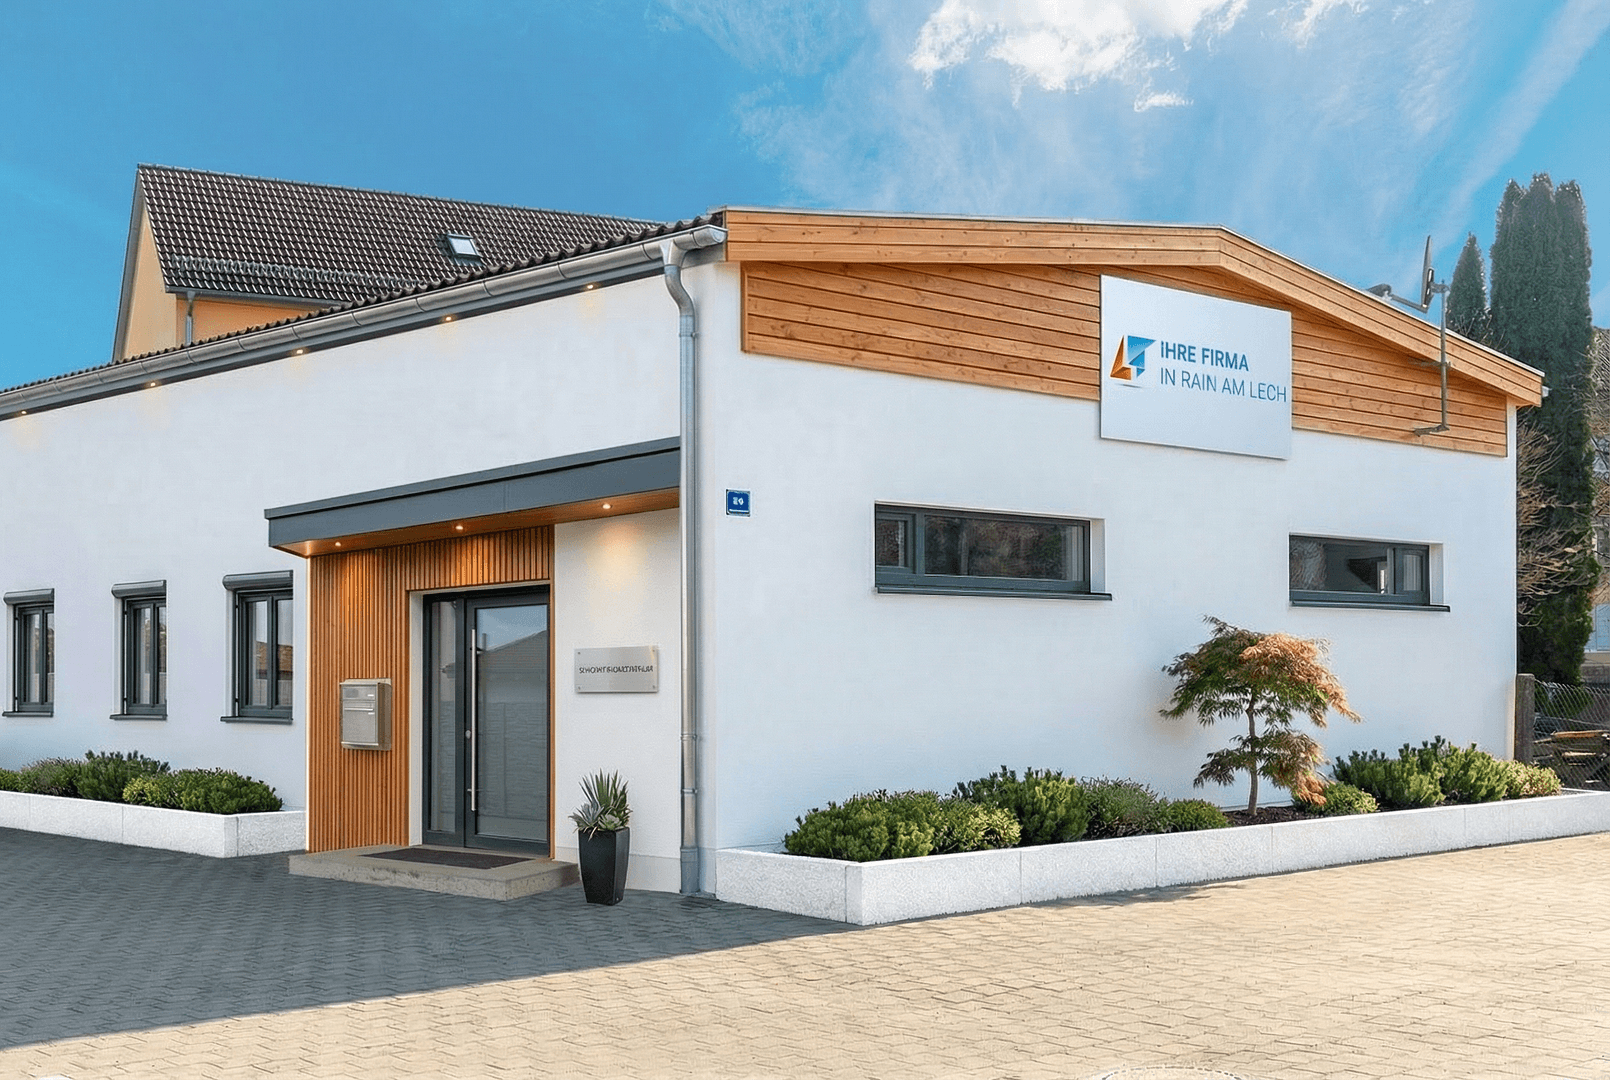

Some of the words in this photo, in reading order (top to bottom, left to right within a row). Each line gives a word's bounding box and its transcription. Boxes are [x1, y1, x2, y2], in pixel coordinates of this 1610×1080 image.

[1160, 340, 1197, 363] IHRE
[1201, 347, 1249, 371] FIRMA
[1160, 367, 1176, 386] IN
[1181, 370, 1217, 392] RAIN
[1221, 377, 1245, 396] AM
[1249, 381, 1287, 402] LECH
